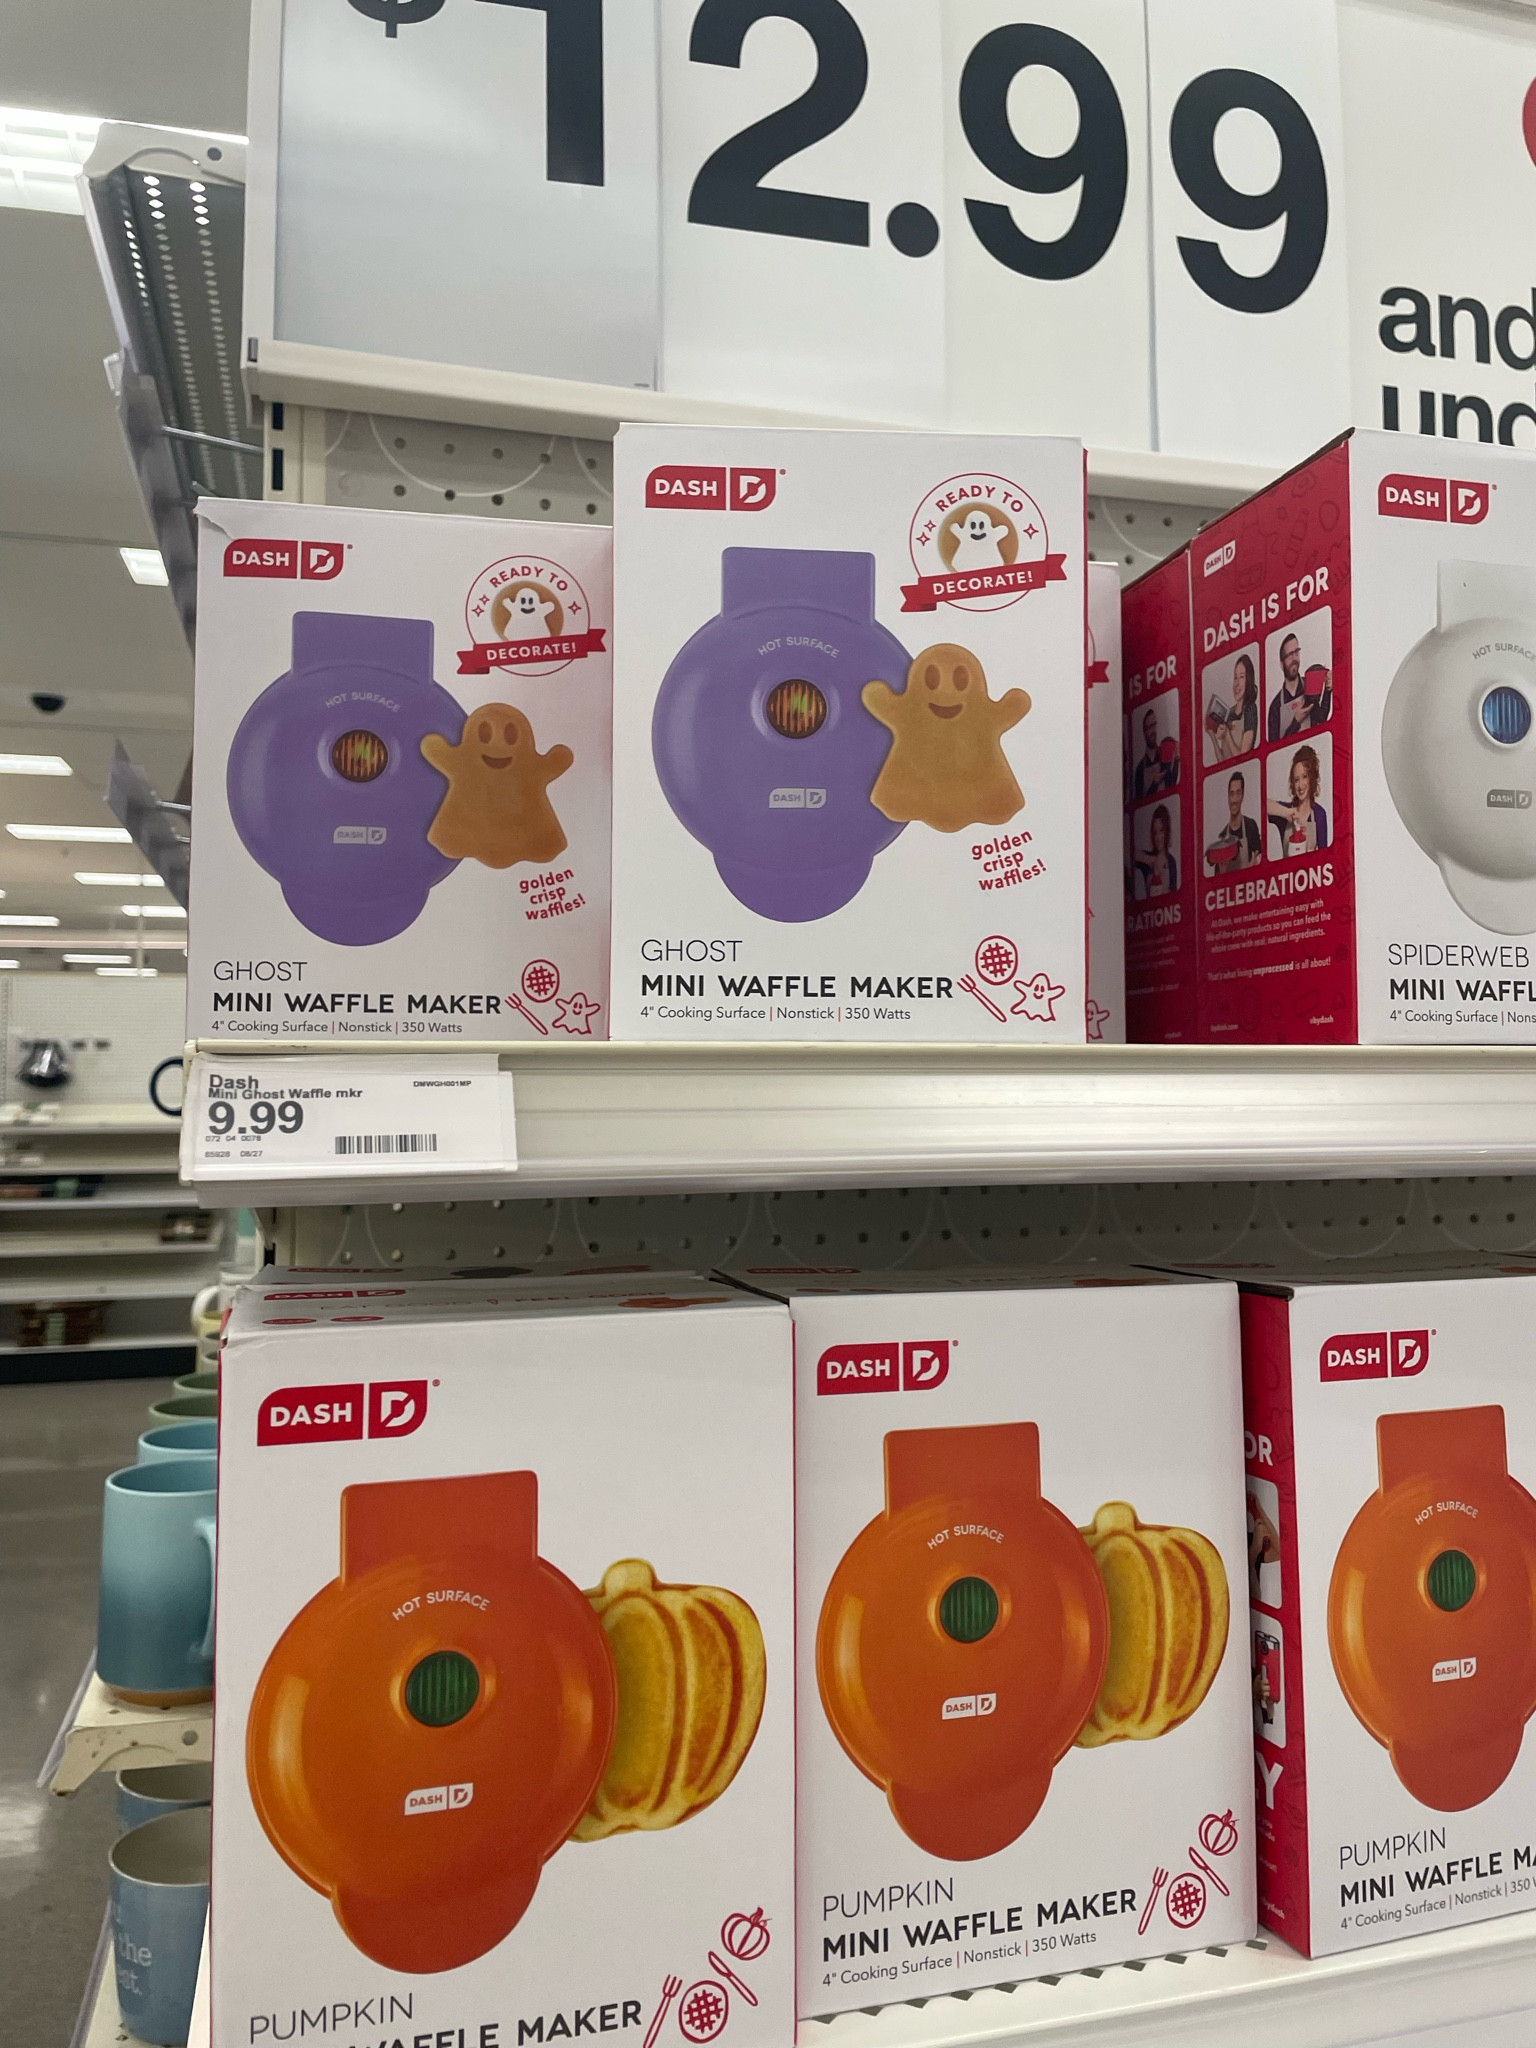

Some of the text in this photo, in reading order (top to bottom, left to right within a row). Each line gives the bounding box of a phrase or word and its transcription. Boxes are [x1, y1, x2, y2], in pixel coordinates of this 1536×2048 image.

[346, 0, 1329, 314] 12.99
[1379, 286, 1536, 371] and
[655, 479, 717, 497] DASH
[936, 484, 1025, 514] READY TO
[1385, 486, 1440, 508] DASH
[231, 550, 290, 567] DASH
[490, 564, 569, 592] READY TO
[932, 571, 1035, 596] DECORATE!
[1204, 566, 1329, 653] DASH IS FOR
[486, 641, 577, 661] DECORATE!
[757, 636, 841, 659] HOT SURFACE
[1472, 644, 1492, 660] HOT
[1129, 654, 1177, 699] IS FOR
[324, 691, 401, 713] HOT SURFACE
[773, 793, 801, 803] DASH
[1490, 794, 1513, 804] DASH
[971, 831, 1034, 860] golden
[982, 850, 1025, 874] crisp
[518, 868, 575, 894] golden
[978, 858, 1047, 891] waffles!
[529, 885, 568, 906] crisp
[1205, 863, 1335, 912] CELEBRATIONS
[525, 893, 586, 921] waffles!
[1259, 906, 1294, 921] entertaining
[1295, 903, 1309, 914] easy
[1310, 898, 1324, 910] with
[1247, 923, 1272, 936] products
[1273, 922, 1280, 930] so
[1281, 920, 1292, 930] you
[1293, 918, 1304, 927] can
[1305, 913, 1320, 925] feed
[1321, 911, 1332, 922] the
[1268, 934, 1289, 945] natural
[1289, 928, 1326, 942] ingredients.
[641, 939, 743, 962] GHOST
[1388, 943, 1530, 968] SPIDERWEB
[213, 960, 308, 982] GHOST
[1253, 961, 1294, 976] unprocessed
[1295, 959, 1301, 970] is
[1301, 959, 1309, 969] all
[1310, 956, 1331, 968] about!
[641, 974, 953, 999] MINI WAFFLE MAKER
[1390, 978, 1445, 1001] MINI
[213, 992, 501, 1015] MINI WAFFLE MAKER
[640, 1006, 911, 1021] 4" Cooking Surface Nonstick 350 Watts
[211, 1020, 463, 1035] 4" Cooking Surface Nonstick 350 Watts
[1390, 1010, 1402, 1021] 4"
[1405, 1010, 1453, 1025] Cooking
[1456, 1010, 1498, 1022] Surface
[209, 1073, 259, 1089] Dash
[208, 1088, 363, 1100] Mini Ghost Waffle mkr
[208, 1100, 304, 1135] 9.99
[826, 1357, 890, 1379] DASH
[1327, 1347, 1381, 1368] DASH
[269, 1402, 352, 1428] DASH
[1414, 1501, 1479, 1525] HOT SURFACE
[926, 1525, 1005, 1550] HOT SURFACE
[392, 1589, 491, 1621] HOT SURFACE
[1435, 1665, 1457, 1676] DASH
[945, 1701, 973, 1714] DASH
[409, 1793, 443, 1808] DASH
[1340, 1827, 1447, 1870] PUMPKIN
[1340, 1851, 1503, 1908] MINI WAFFLE
[822, 1876, 954, 1922] PUMPKIN
[1341, 1915, 1353, 1930] 4"
[1355, 1907, 1402, 1928] Cooking
[1405, 1898, 1447, 1917] Surface
[1455, 1884, 1502, 1906] Nonstick
[1510, 1878, 1531, 1893] 350
[822, 1888, 1137, 1962] MINI WAFFLE MAKER
[822, 1929, 1097, 1987] 4" Cooking Surface Nonstick 350 Watts
[250, 1992, 413, 2044] PUMPKIN
[518, 1999, 642, 2047] MAKER
